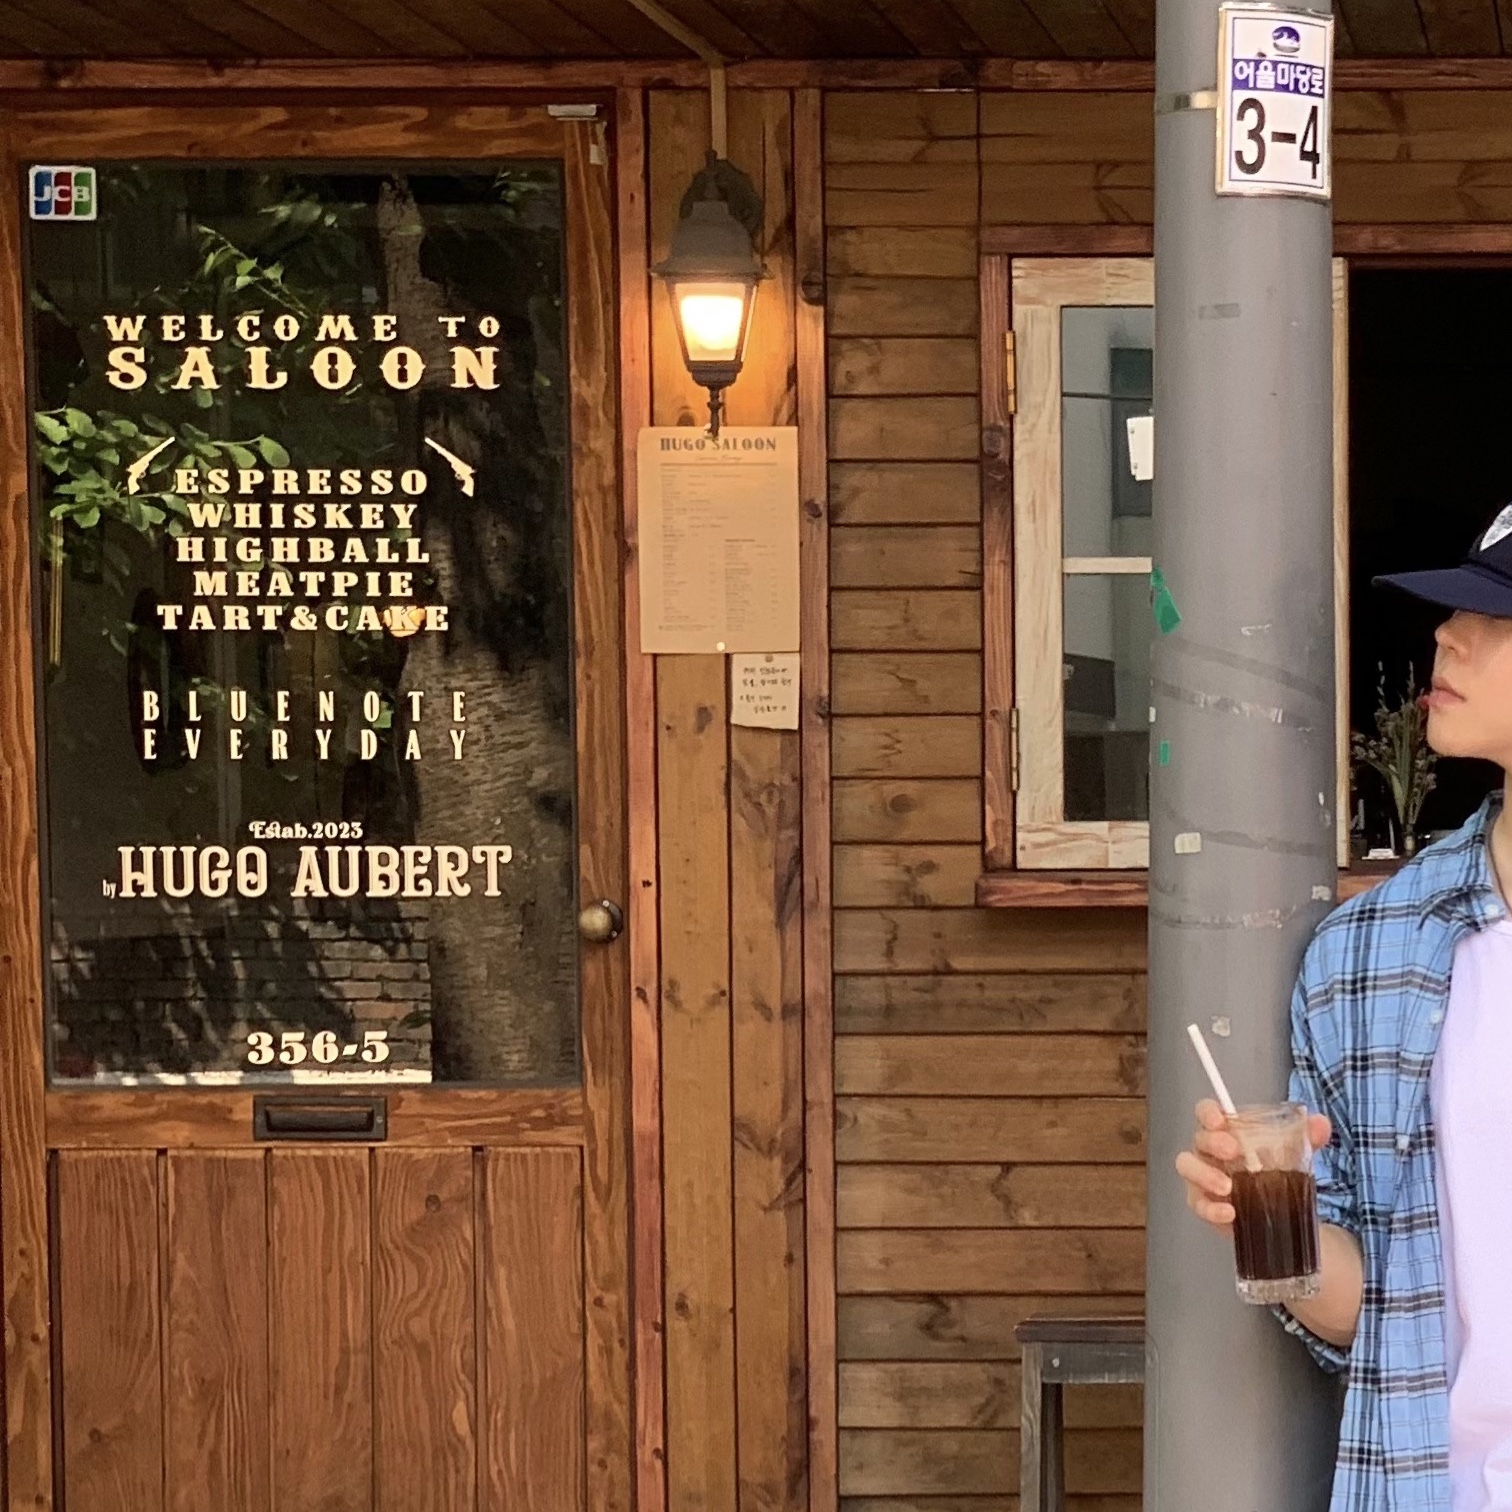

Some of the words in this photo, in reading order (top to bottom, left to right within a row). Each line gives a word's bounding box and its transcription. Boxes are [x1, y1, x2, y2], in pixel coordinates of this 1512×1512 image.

[1234, 60, 1324, 94] 어울마당로
[1235, 97, 1320, 180] 3-4
[36, 184, 91, 202] JCB
[103, 314, 398, 341] WELCOME
[438, 315, 500, 338] TO
[105, 345, 500, 391] SALOON
[660, 438, 706, 451] HUGO
[711, 437, 776, 451] SALOON
[175, 468, 429, 495] ESPRESSO
[187, 503, 418, 529] WHISKEY
[176, 537, 431, 563] HIGHBALL
[193, 570, 414, 597] MEATPIE
[157, 604, 449, 631] TART&CAKE
[143, 690, 467, 722] BLUENOTE
[143, 728, 466, 760] EVERYDAY
[249, 820, 363, 840] Estab.2023
[102, 878, 117, 899] by
[117, 845, 268, 898] HUGO
[290, 845, 512, 898] AUBERT
[246, 1030, 390, 1065] 356-5
